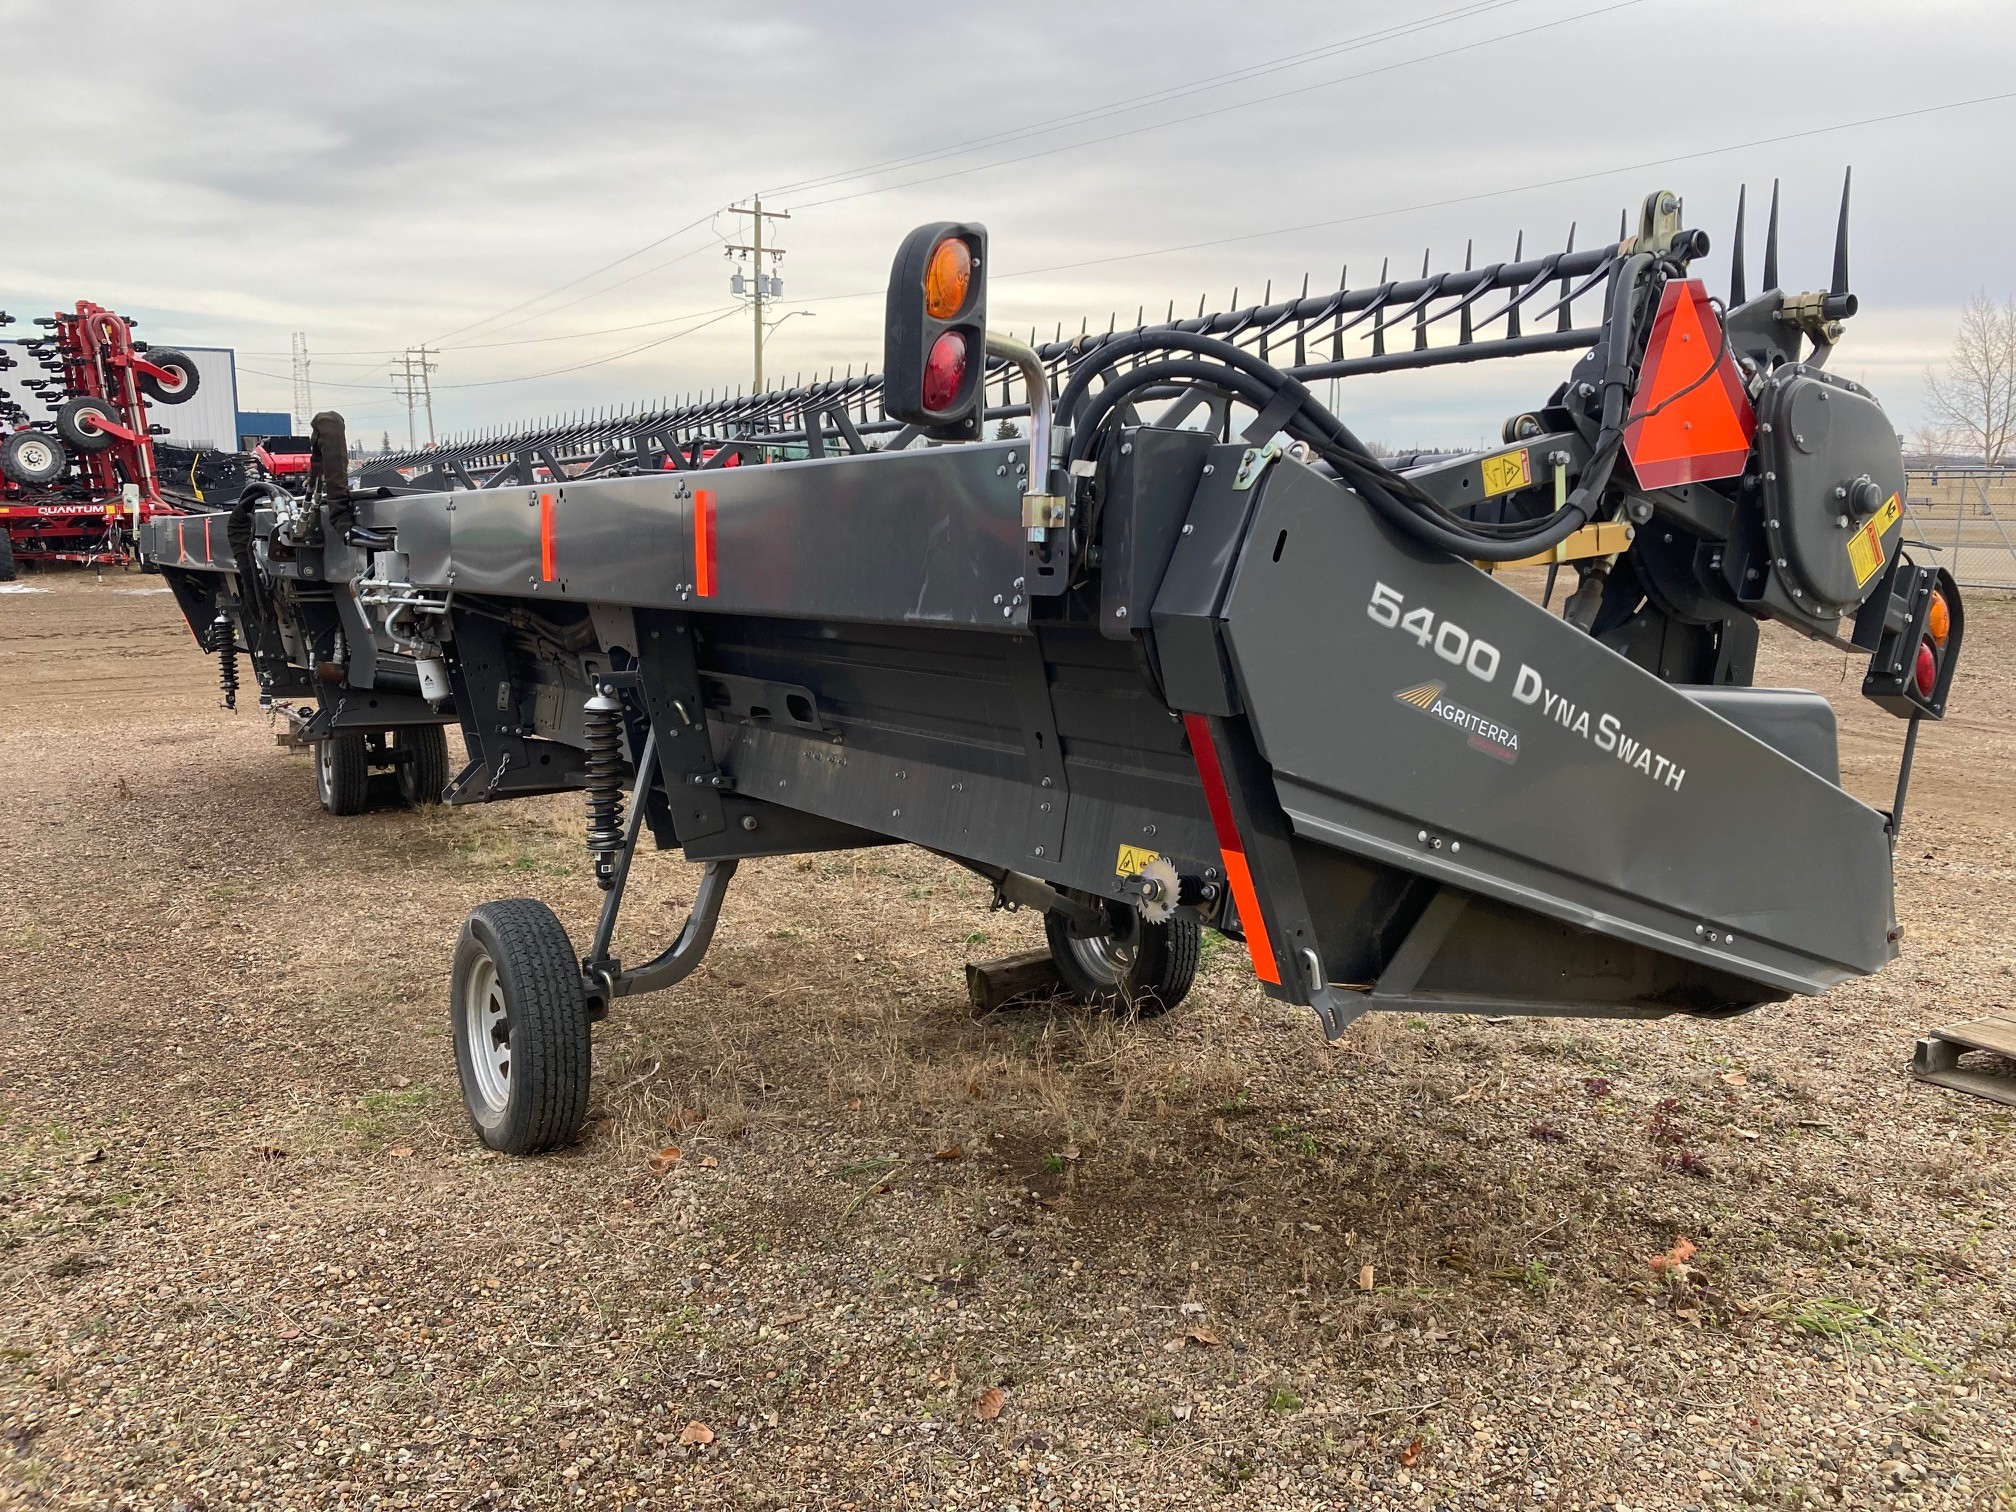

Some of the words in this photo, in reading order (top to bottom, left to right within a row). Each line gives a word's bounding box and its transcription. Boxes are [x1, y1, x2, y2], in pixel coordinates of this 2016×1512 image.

[38, 505, 104, 515] QUANTUM
[1367, 581, 1500, 683] 5400
[1431, 700, 1518, 750] AGRITERRA
